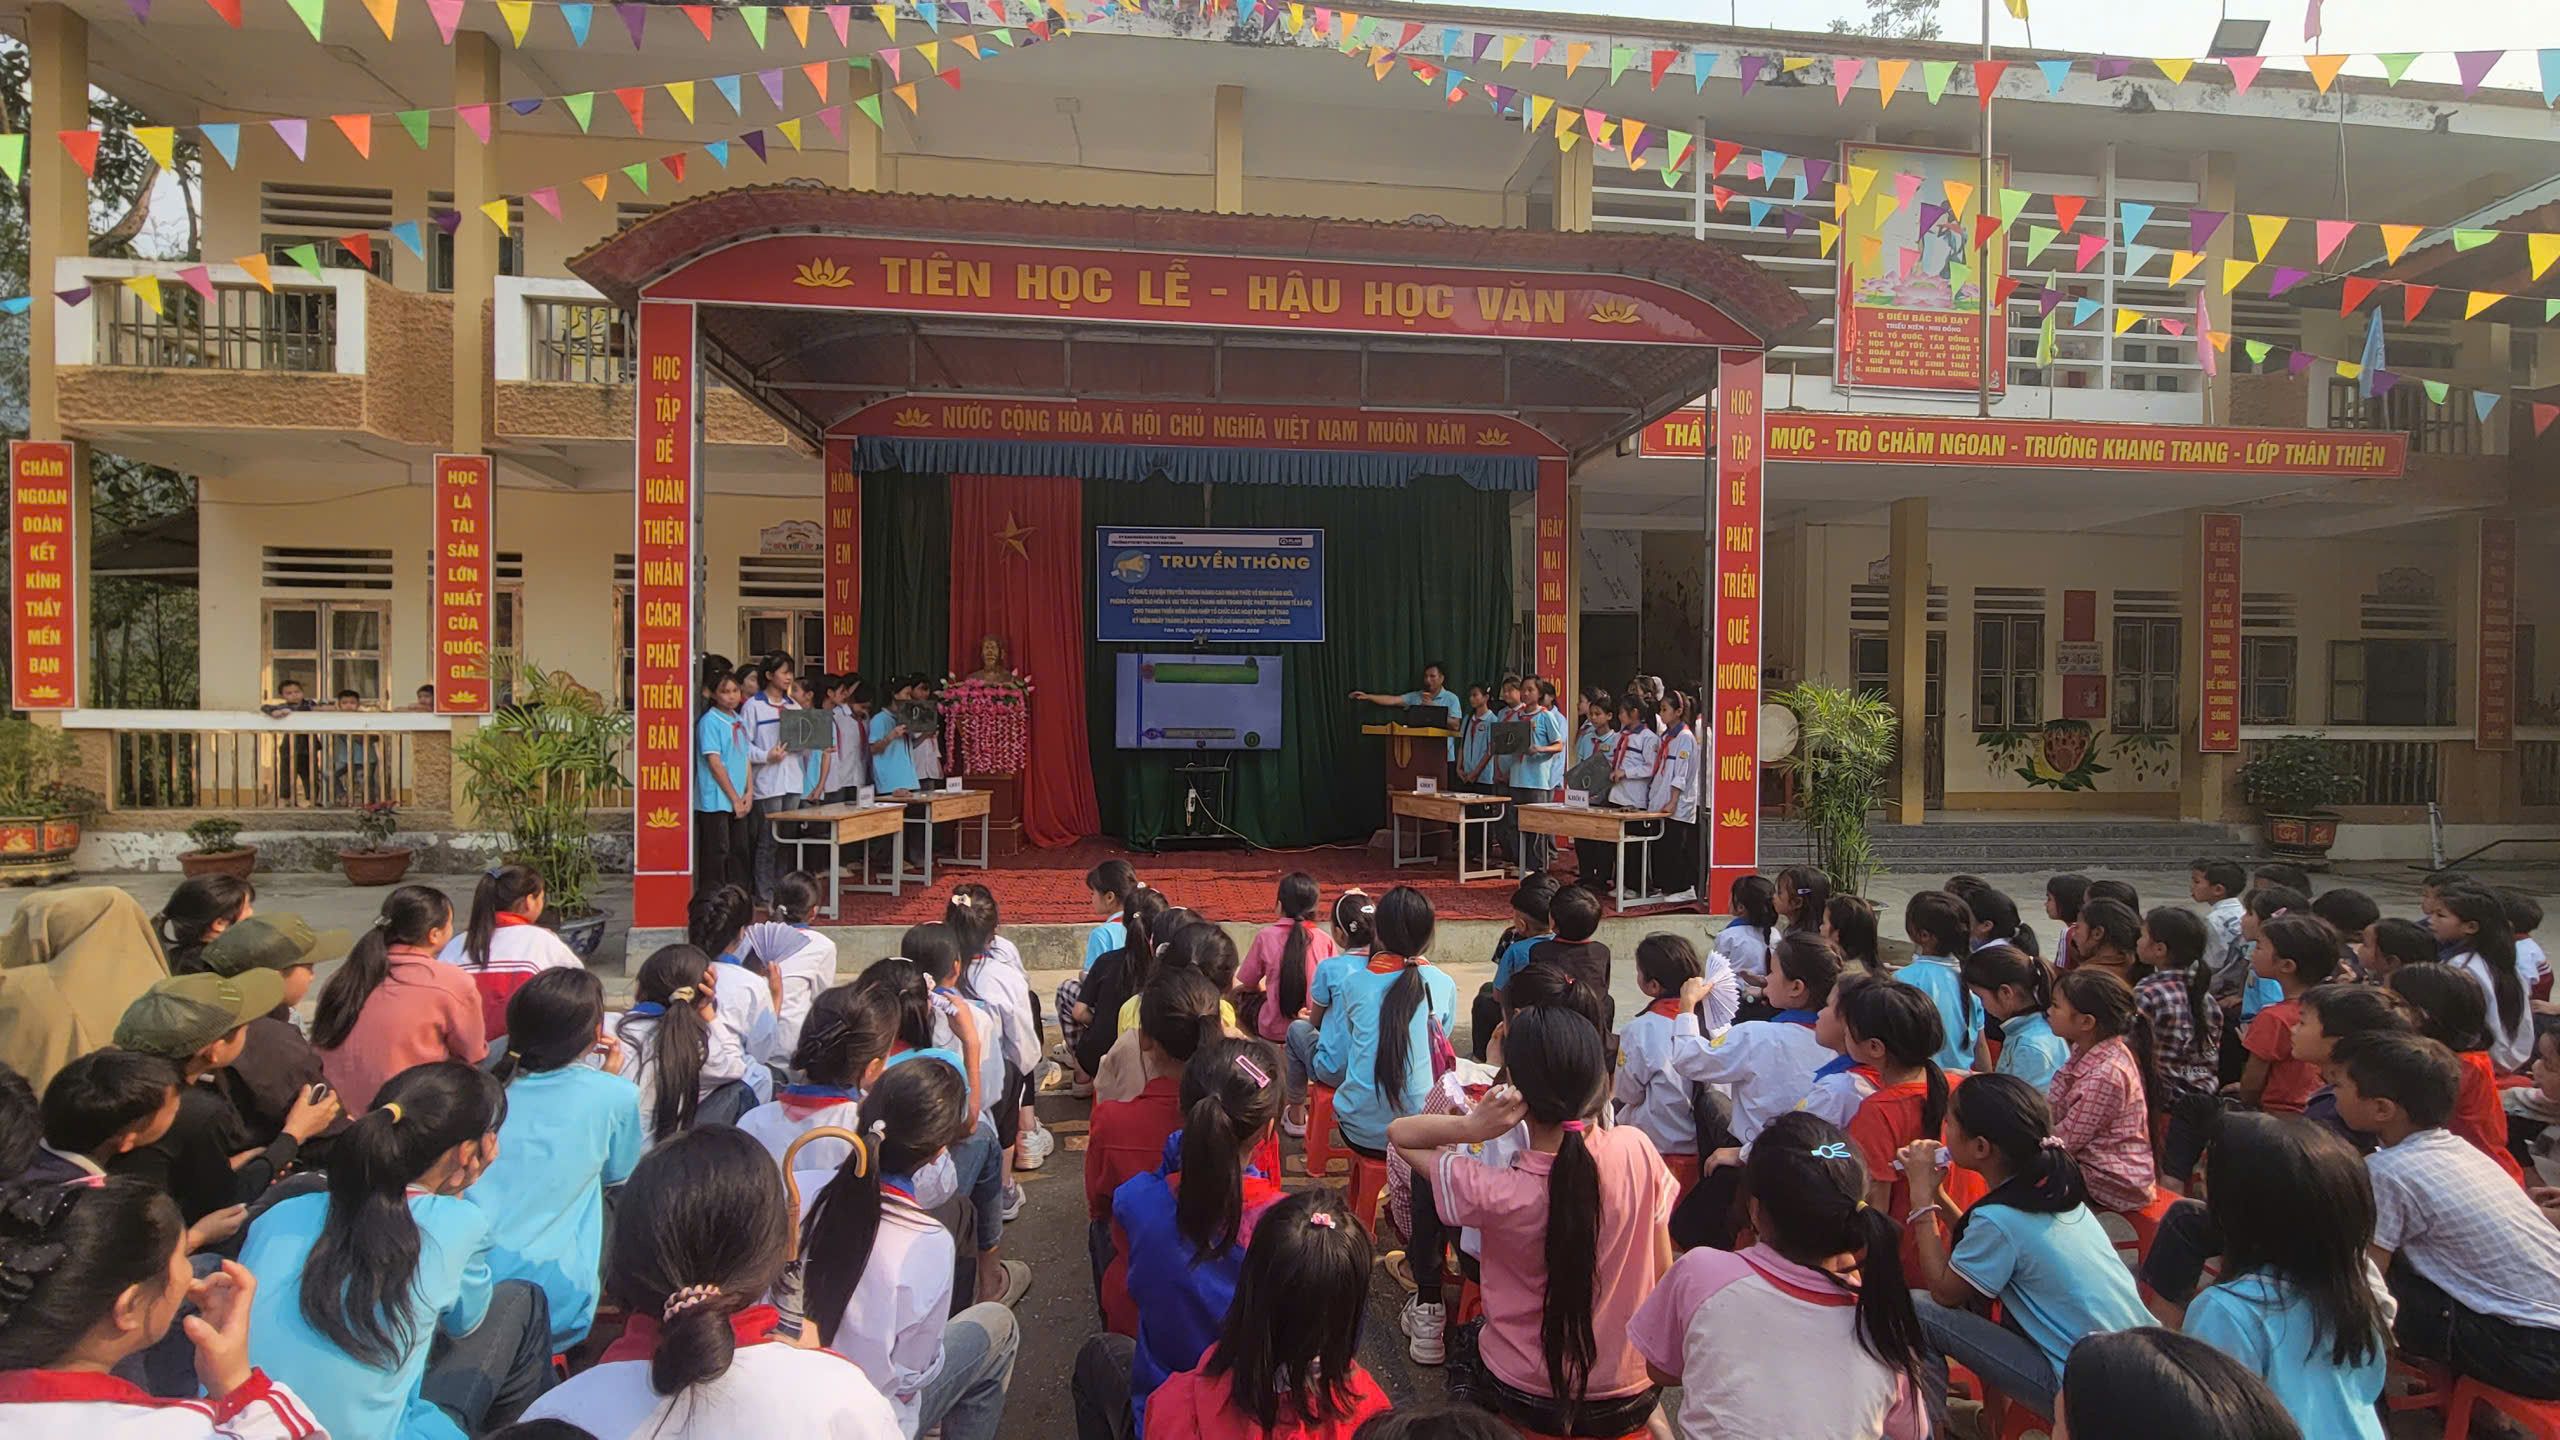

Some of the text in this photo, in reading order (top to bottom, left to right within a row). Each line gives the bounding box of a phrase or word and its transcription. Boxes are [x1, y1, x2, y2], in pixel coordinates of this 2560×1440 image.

[880, 251, 991, 298] TIÊN
[1017, 264, 1112, 309] HỌC
[1138, 258, 1192, 308] LỄ
[1248, 270, 1341, 319] HẬU
[1364, 281, 1455, 325] HỌC
[1477, 280, 1566, 324] VĂN
[1878, 312, 1884, 320] 5
[1912, 313, 1931, 322] BÁC
[1951, 316, 1969, 325] DẠY
[653, 355, 681, 385] HỌC
[656, 393, 681, 426] TẬP
[1730, 389, 1752, 420] HỌC
[943, 401, 1466, 445] NƯỚC CỘNG HÒA XÃ HỘI CHỦ NGHĨA VIỆT NAM MUÔN NĂM
[656, 428, 674, 463] ĐỂ
[1732, 430, 1752, 465] TẬP
[1770, 427, 1815, 455] MỰC
[1836, 426, 1871, 452] TRÒ
[1878, 427, 1934, 454] CHĂM
[1940, 433, 2006, 456] NGOAN
[2024, 432, 2097, 460] TRƯỜNG
[2102, 438, 2165, 462] KHANG
[2171, 441, 2228, 463] TRANG
[2246, 438, 2280, 465] LỚP
[2285, 442, 2330, 467] THÂN
[2335, 444, 2385, 471] THIỆN
[20, 458, 63, 477] CHĂM
[448, 470, 478, 487] HỌC
[17, 488, 67, 505] NGOAN
[454, 493, 472, 509] LÀ
[646, 474, 684, 504] HOÀN
[1732, 472, 1747, 506] ĐỂ
[451, 517, 475, 533] TÀI
[833, 508, 852, 529] NAY
[1540, 515, 1564, 538] NGÀY
[643, 515, 684, 549] THIỆN
[1726, 522, 1753, 552] PHÁT
[30, 541, 56, 561] KẾT
[448, 540, 479, 558] SẢN
[836, 543, 850, 564] EM
[1159, 550, 1310, 570] TRUYỀN THÔNG
[1543, 551, 1561, 570] MAI
[25, 570, 61, 589] KÍNH
[448, 565, 478, 582] LỚN
[644, 557, 684, 586] NHÂN
[1723, 563, 1756, 599] TRIỂN
[443, 588, 483, 606] NHẤT
[836, 579, 850, 604] TỰ
[1542, 579, 1561, 601] NHÀ
[25, 597, 62, 617] THẦY
[645, 598, 681, 627] CÁCH
[448, 613, 479, 630] CỦA
[833, 611, 854, 636] HÀO
[1537, 610, 1567, 634] TRƯỜNG
[1727, 615, 1750, 647] QUÊ
[28, 626, 61, 645] MẾN
[443, 637, 484, 655] QUỐC
[646, 639, 681, 668] PHÁT
[837, 644, 850, 671] VỀ
[1546, 645, 1557, 669] TỰ
[29, 657, 60, 677] BẠN
[451, 665, 476, 679] GIA
[1718, 663, 1757, 690] HƯƠNG
[642, 674, 683, 709] TRIỂN
[648, 716, 679, 749] BẢN
[1726, 704, 1748, 736] ĐẤT
[641, 761, 681, 791] THÂN
[1721, 751, 1751, 782] NƯỚC
